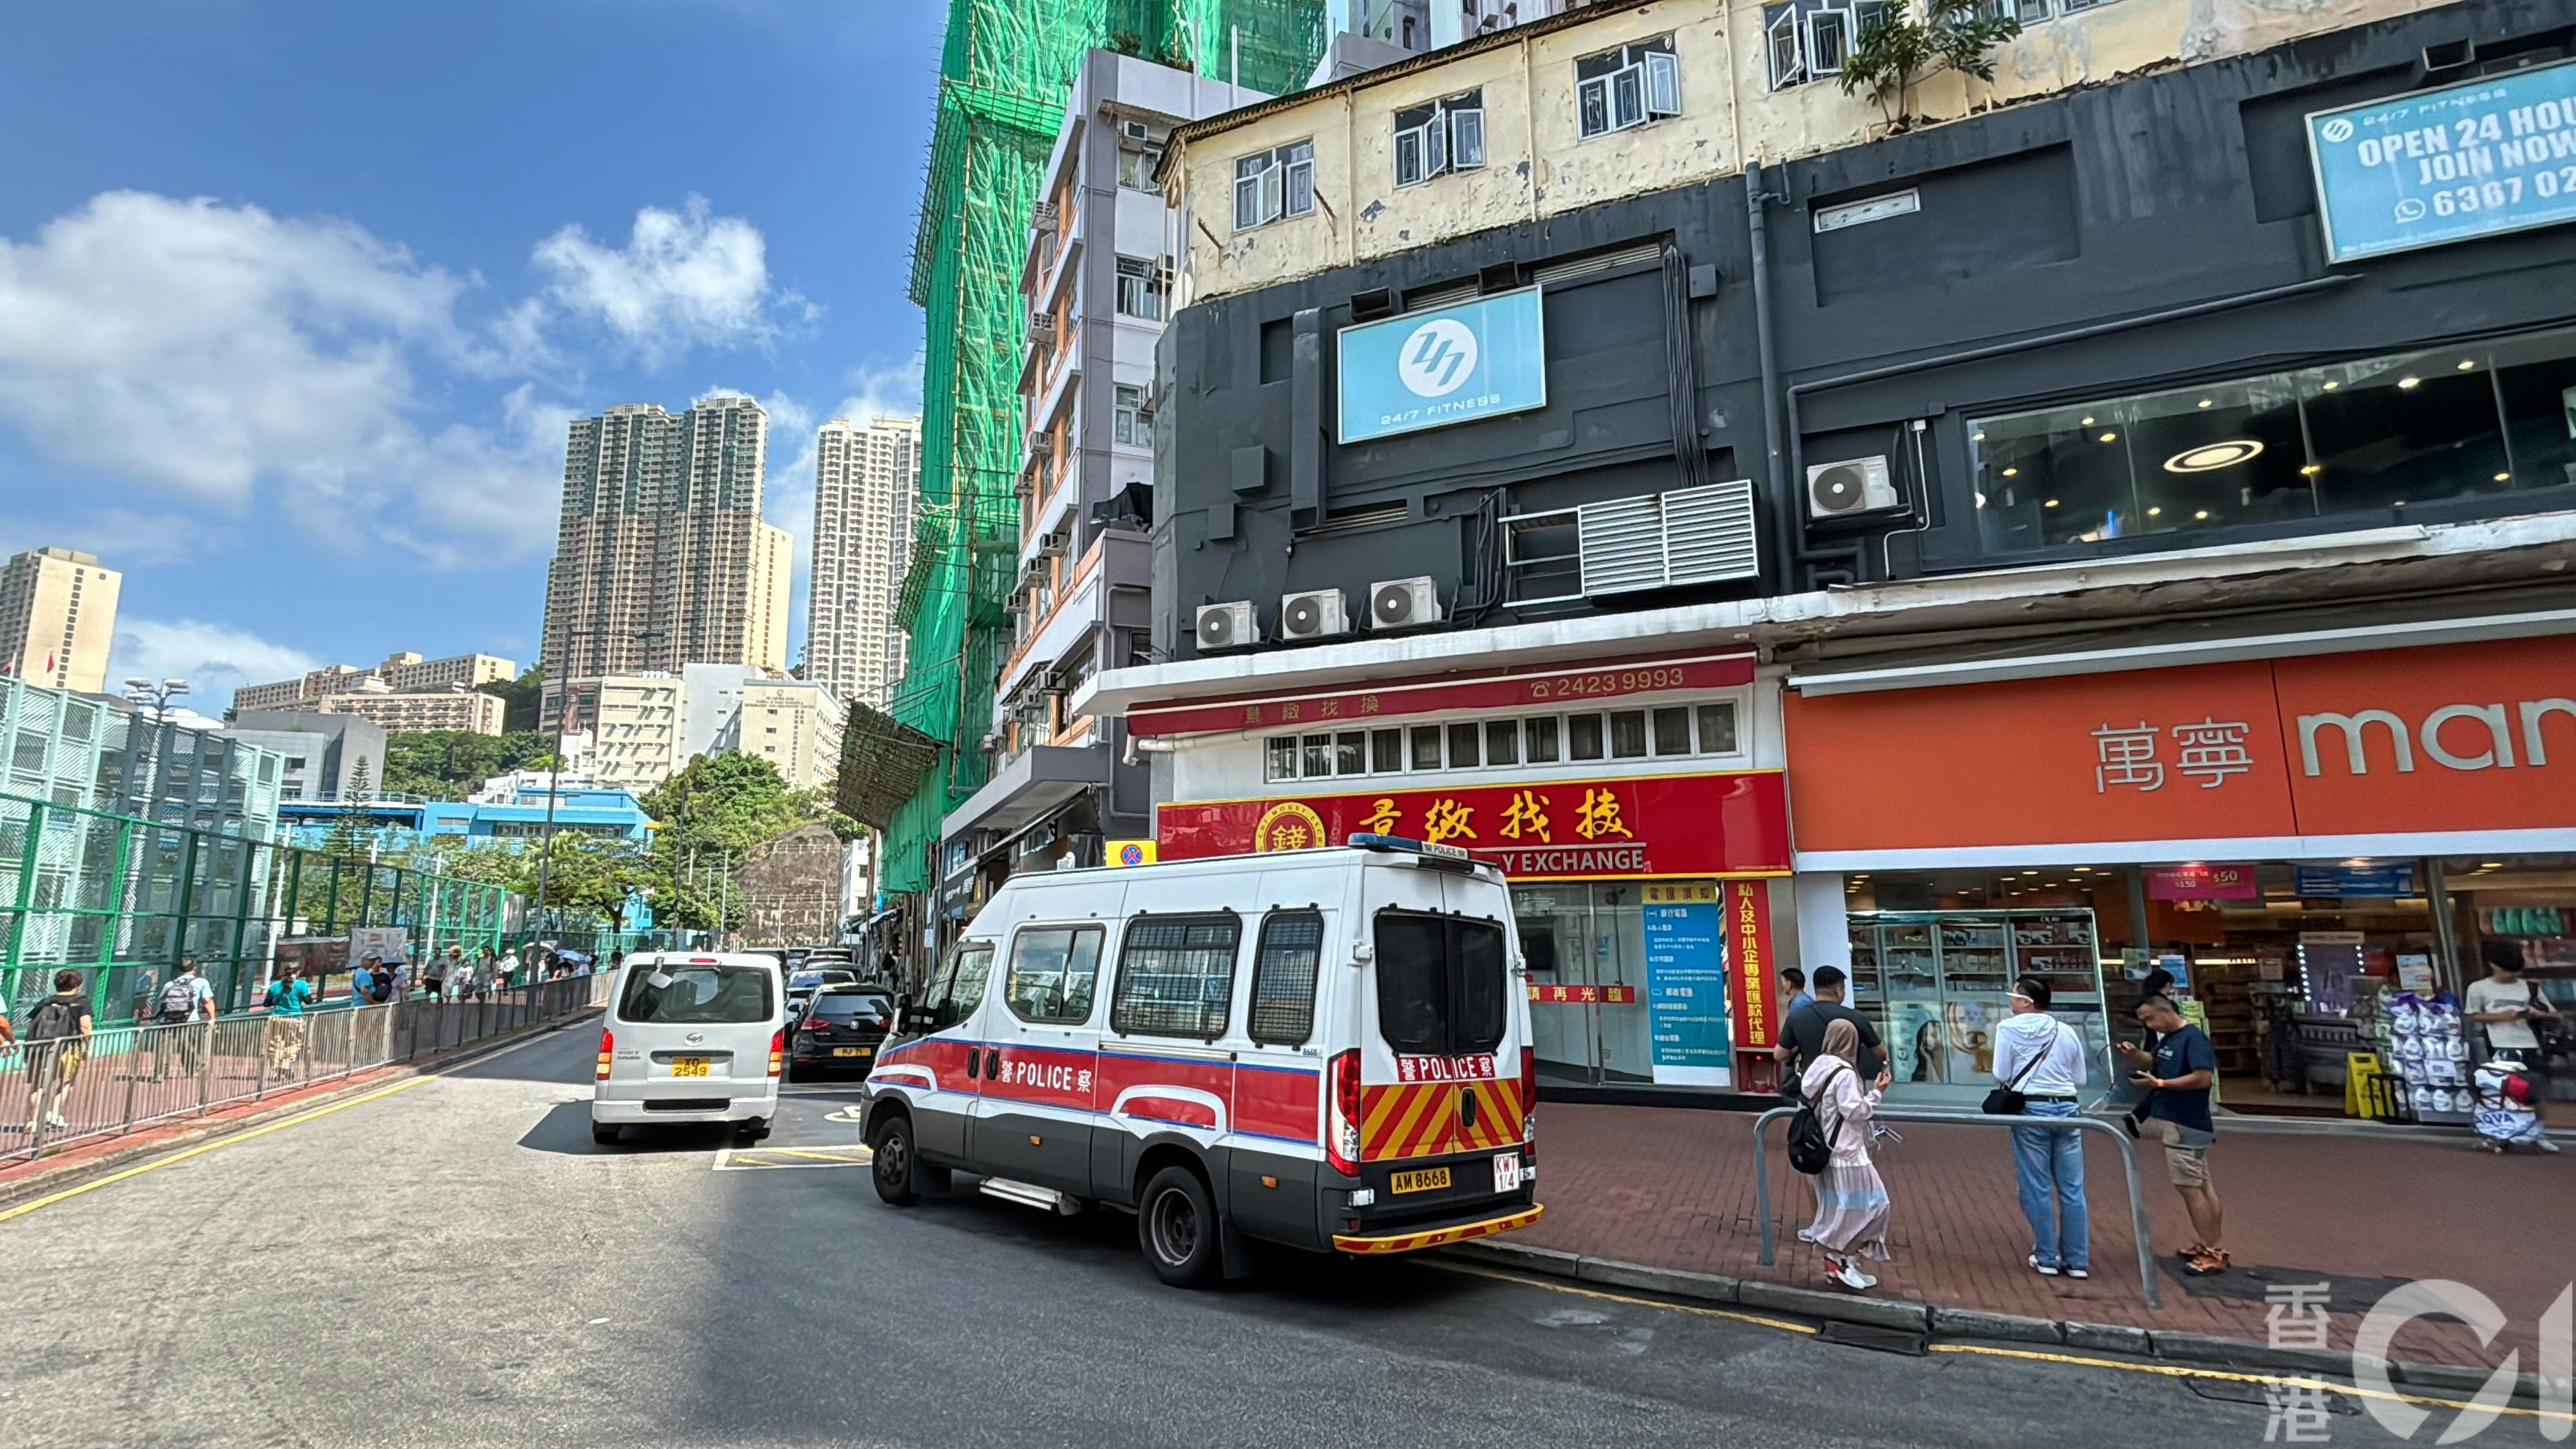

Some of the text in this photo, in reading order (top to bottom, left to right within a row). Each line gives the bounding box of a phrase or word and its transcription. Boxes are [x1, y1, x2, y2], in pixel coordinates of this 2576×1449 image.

[2419, 88, 2507, 115] FITNESS
[2357, 124, 2449, 167] OPEN
[2455, 113, 2502, 148] 24
[2419, 146, 2494, 185] JOIN
[2432, 176, 2523, 217] 6367
[1380, 394, 1501, 425] 24/7 FITNESS
[1557, 667, 1683, 697] 2423 9993
[2089, 714, 2254, 793] 萬寧
[1433, 845, 1458, 857] POLICE
[1521, 848, 1644, 872] EXCHANGE
[1001, 1060, 1092, 1093] 警 POLICE 察
[1400, 1056, 1492, 1081] 警 POLICE 察
[1495, 1155, 1516, 1174] KWT
[1396, 1169, 1448, 1191] AM 8668
[1499, 1172, 1515, 1191] 1/4
